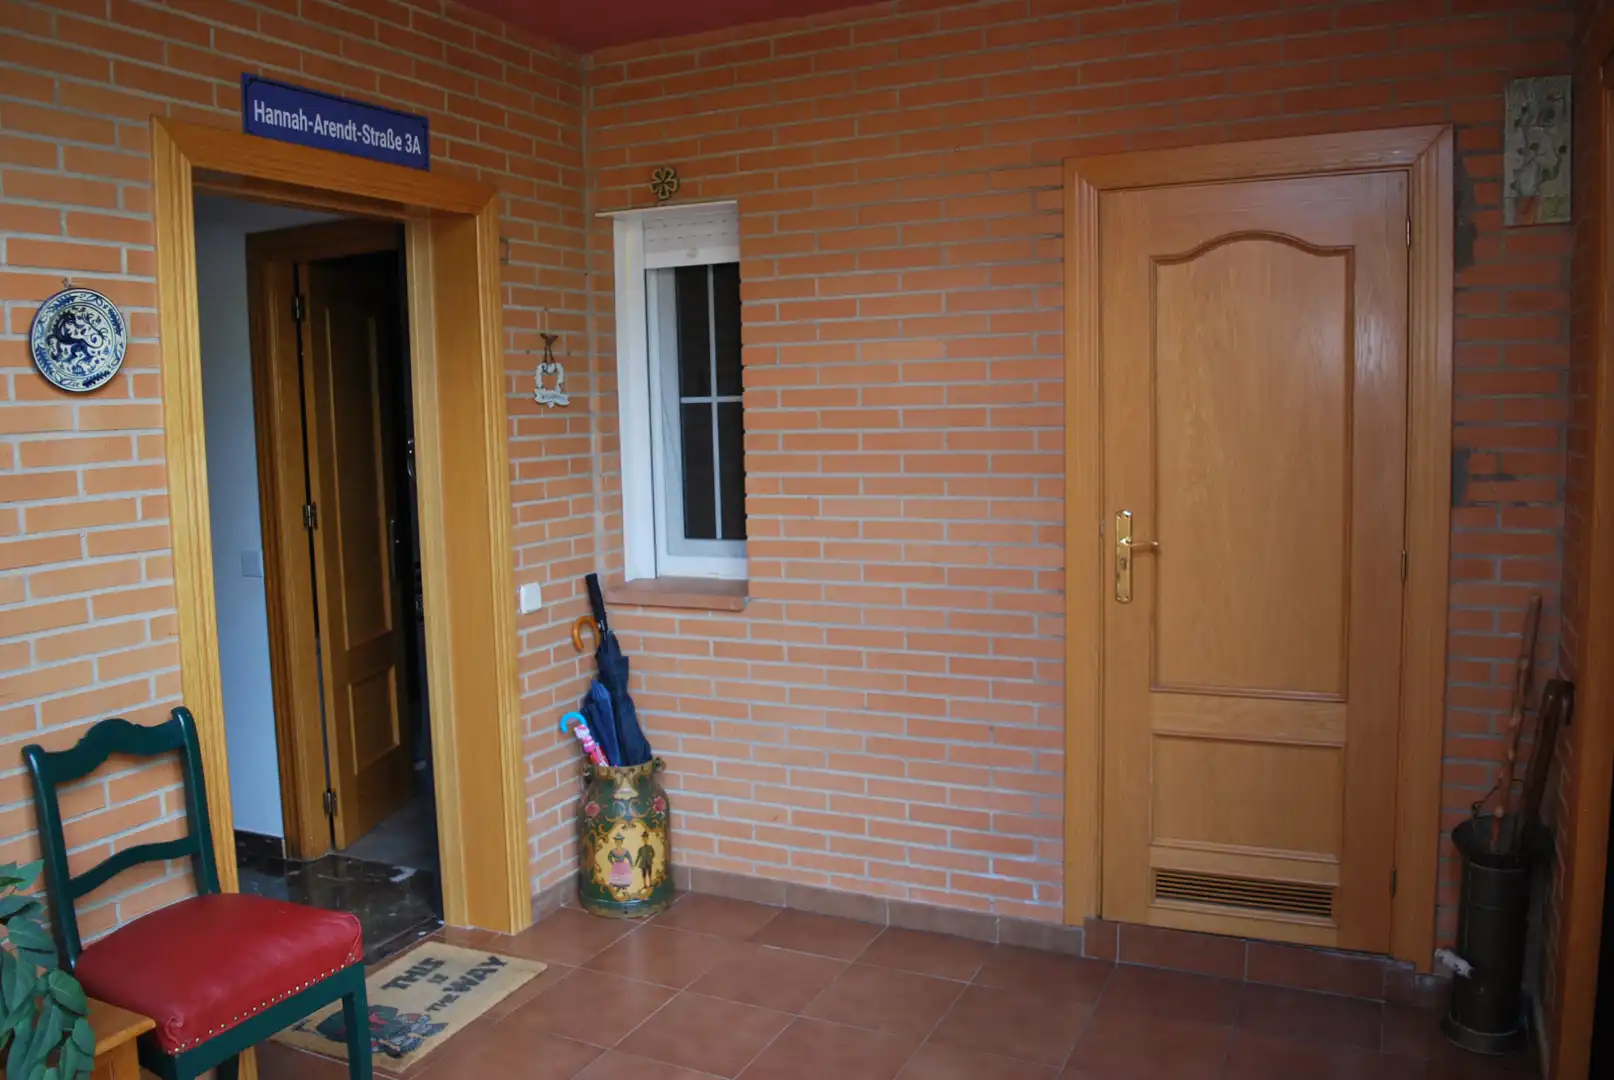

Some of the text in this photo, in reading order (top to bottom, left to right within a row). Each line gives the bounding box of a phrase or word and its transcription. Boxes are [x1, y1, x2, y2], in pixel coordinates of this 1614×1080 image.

[254, 100, 422, 155] Hannah-Arendt-Straße 3A
[380, 957, 443, 989] THIS
[442, 956, 508, 992] WAY
